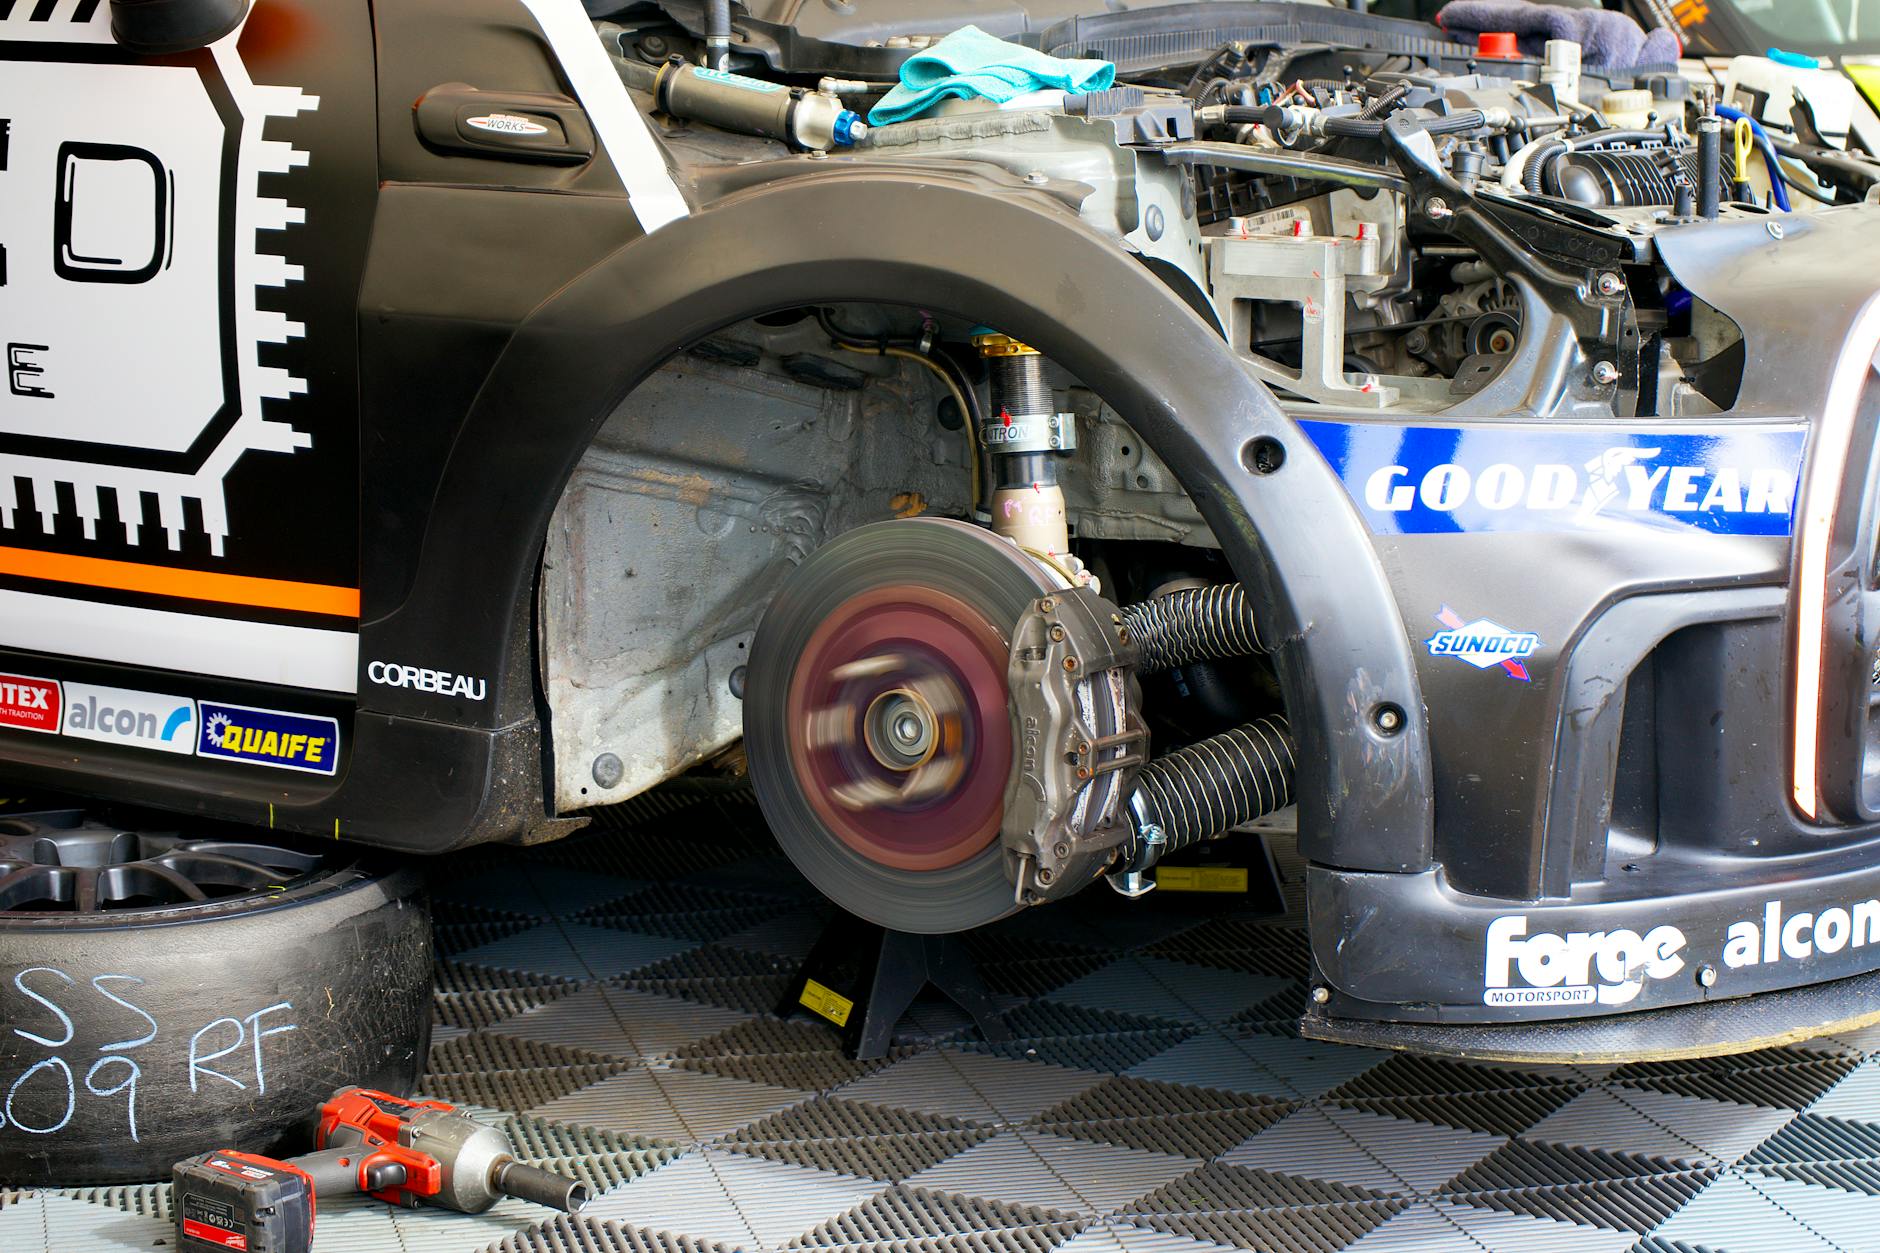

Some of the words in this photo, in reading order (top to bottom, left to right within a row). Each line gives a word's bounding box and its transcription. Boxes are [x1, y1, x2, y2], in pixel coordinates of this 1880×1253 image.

[487, 120, 525, 131] WORKS
[1435, 635, 1533, 653] SUNOCO
[0, 682, 49, 710] TEX
[367, 660, 486, 701] CORBEAU
[8, 709, 44, 721] TRADITION
[69, 696, 157, 739] alcon
[221, 725, 326, 763] QUAIFE
[1023, 716, 1040, 772] alcon
[1722, 899, 1880, 968] alcon
[13, 967, 158, 1052] SS
[1491, 989, 1590, 1003] MOTORSPORT
[189, 1002, 297, 1095] RF
[0, 1056, 141, 1143] 09
